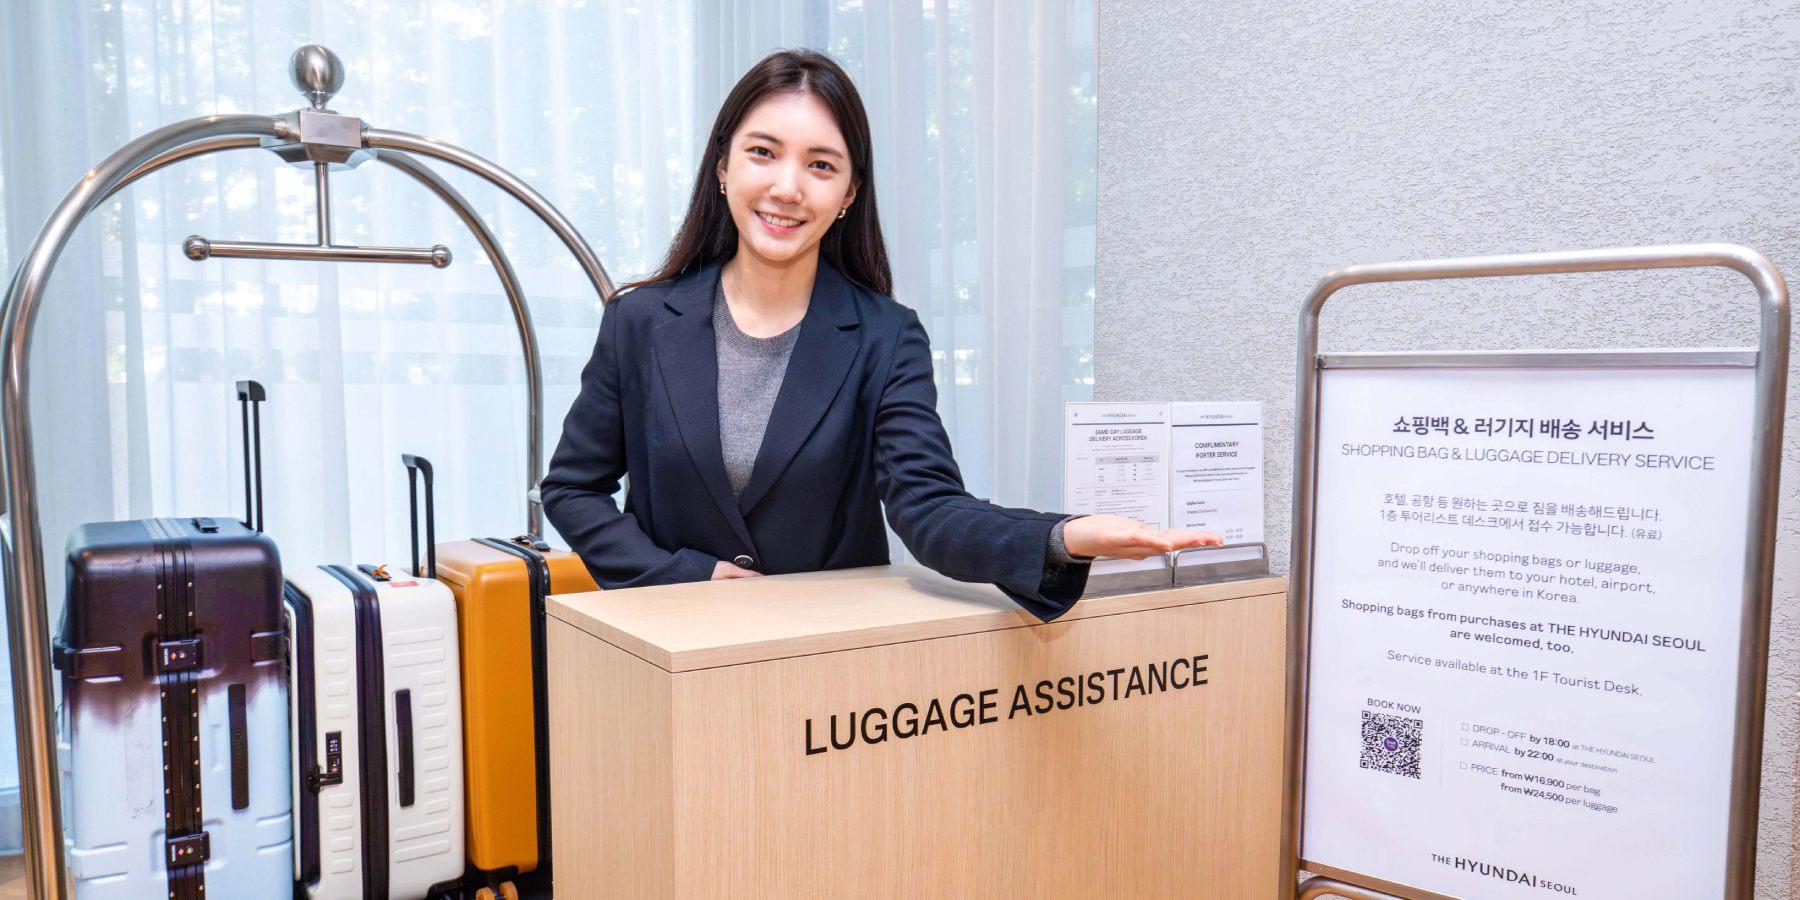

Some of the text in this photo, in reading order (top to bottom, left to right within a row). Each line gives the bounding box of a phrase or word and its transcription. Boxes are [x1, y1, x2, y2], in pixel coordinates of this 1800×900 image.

[1392, 416, 1654, 440] 쇼핑백 & 러기지 배송 서비스
[1341, 443, 1714, 470] SHOPPING BAG & LUGGAGE DELIVERY SERVICE
[1411, 495, 1433, 508] 공항
[1437, 496, 1448, 508] 등
[1452, 496, 1487, 511] 원하는
[1491, 499, 1528, 513] 곳으로
[1533, 502, 1558, 516] 짐을
[1561, 504, 1662, 522] 배송해드립니다.
[1380, 510, 1662, 541] 1층 투어리스트 데스크에서 접수 가능합니다. (유료)
[1390, 542, 1641, 575] Drop off your shopping bags or luggage,
[1378, 558, 1398, 568] and
[1429, 562, 1470, 575] deliver
[1473, 566, 1505, 578] them
[1509, 570, 1523, 580] to
[1526, 574, 1556, 583] your
[1559, 574, 1598, 589] hotel,
[1601, 580, 1656, 595] airport,
[1441, 581, 1580, 604] or anywhere in Korea.
[1341, 598, 1706, 652] Shopping bags from purchases at THE HYUNDAI SEOUL
[1450, 630, 1574, 654] are welcomed, too.
[1387, 650, 1643, 697] Service available at the 1F Tourist Desk.
[805, 654, 1209, 756] LUGGAGE ASSISTANCE
[1367, 698, 1422, 714] BOOK NOW
[1472, 740, 1511, 754] ARRIVAL
[1514, 747, 1526, 758] by
[1527, 749, 1554, 762] 22:00
[1564, 759, 1579, 767] your
[1580, 760, 1618, 774] destination
[1473, 724, 1500, 735] DROP
[1507, 730, 1526, 740] OFF
[1529, 734, 1541, 745] by
[1544, 736, 1570, 748] 18:00
[1581, 744, 1595, 753] THE
[1596, 747, 1629, 759] HYUNDAI
[1630, 752, 1656, 764] SEOUL
[1471, 763, 1601, 797] PRICE from ₩16,900 per bag
[1501, 783, 1618, 814] from ₩24,500 per luggage
[1431, 853, 1578, 896] THE HYUNDAI SEOUL
